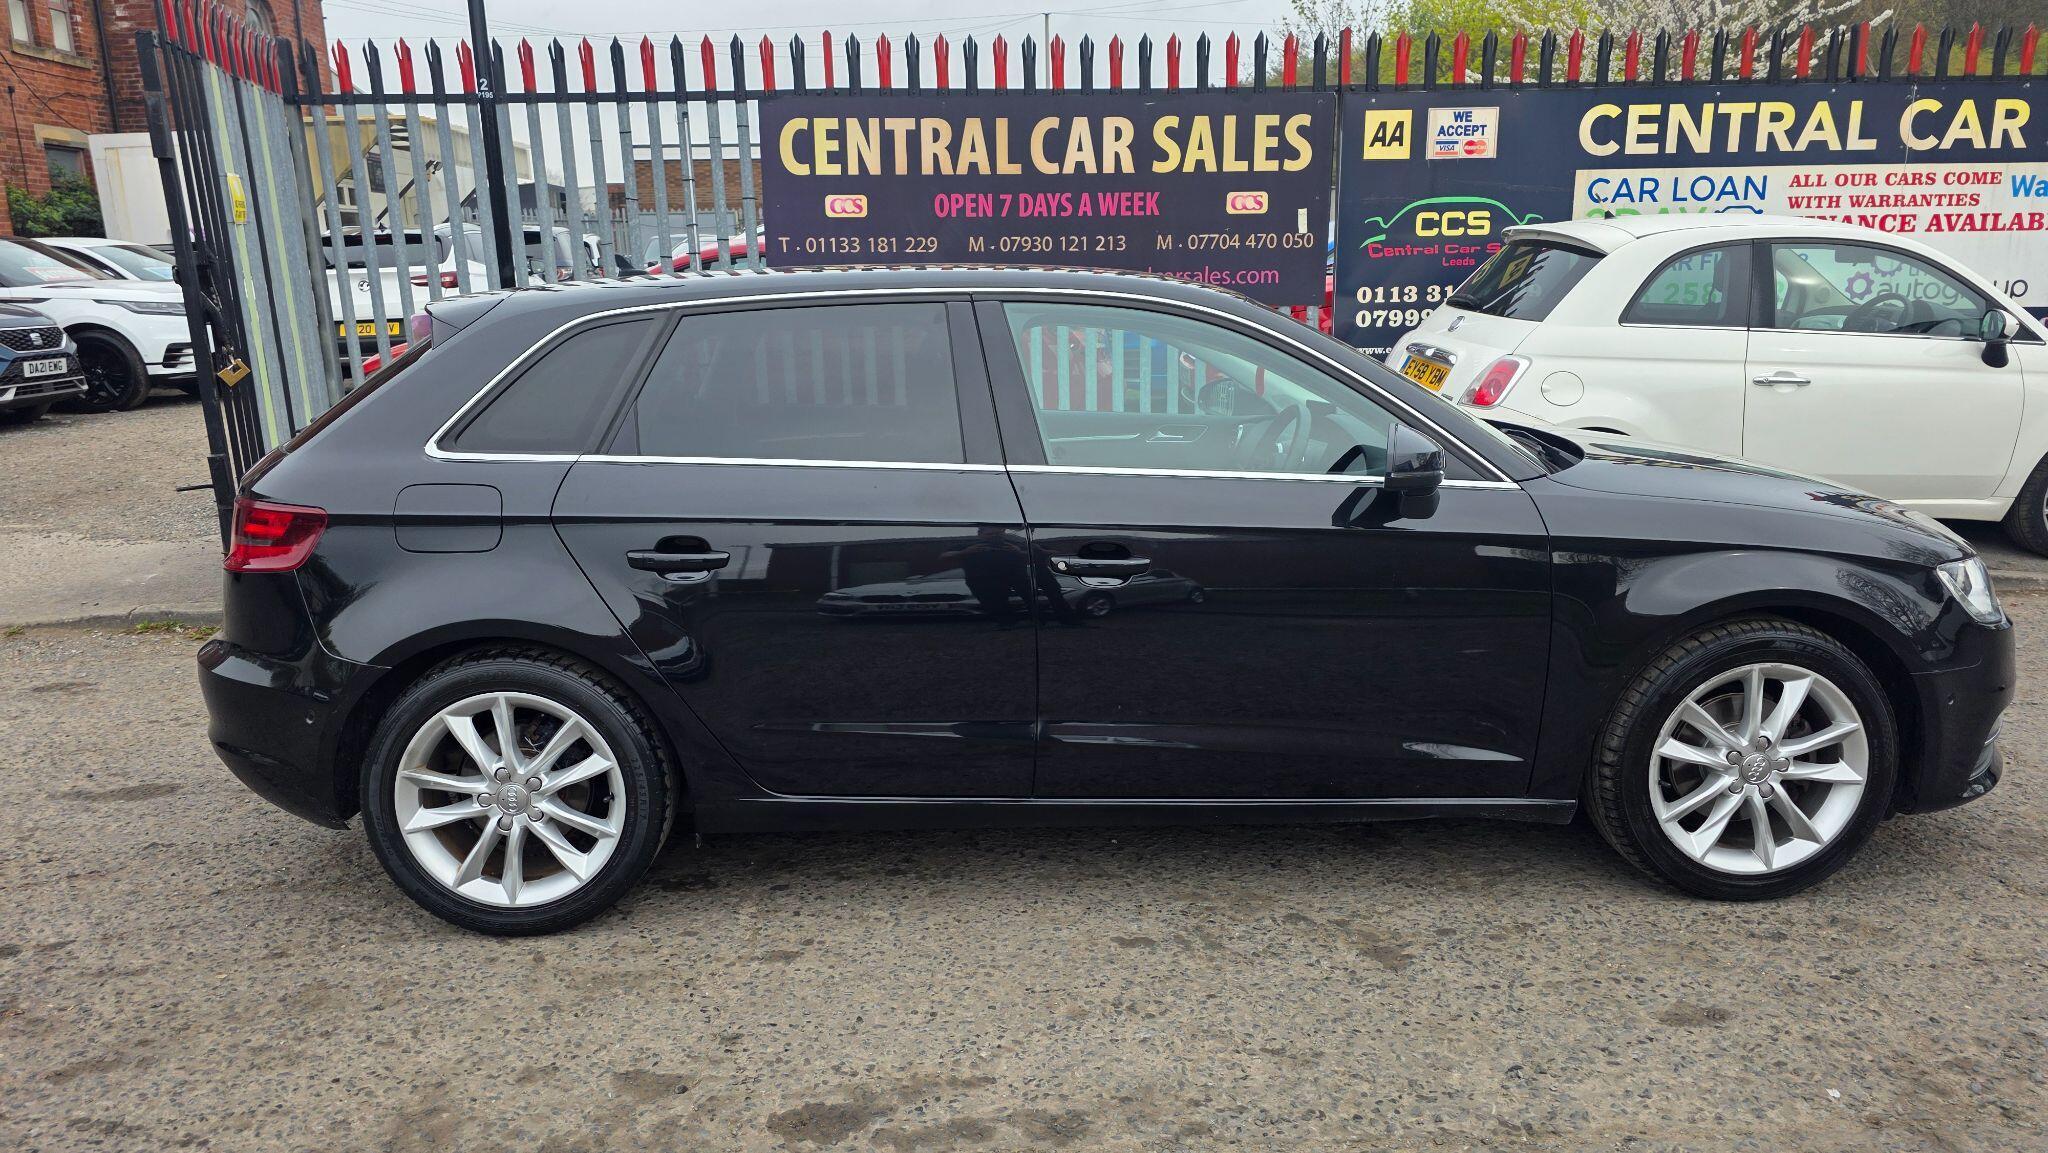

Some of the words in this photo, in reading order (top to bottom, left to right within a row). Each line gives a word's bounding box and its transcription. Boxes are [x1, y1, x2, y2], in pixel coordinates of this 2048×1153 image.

[480, 78, 488, 90] 2
[1453, 111, 1473, 123] WE
[1369, 121, 1405, 147] AA
[1437, 124, 1488, 137] ACCEPT
[1579, 101, 1877, 156] CENTRAL
[1899, 98, 2031, 151] CAR
[779, 117, 1022, 176] CENTRAL
[1030, 116, 1135, 175] CAR
[1152, 114, 1313, 173] SALES
[1788, 173, 1827, 188] ALL
[1834, 172, 1878, 187] OUR
[1885, 171, 1937, 186] CARS
[1943, 171, 2003, 185] COME
[1587, 177, 1660, 204] CAR
[1672, 175, 1768, 202] LOAN
[829, 198, 864, 215] CCS
[934, 193, 993, 218] OPEN
[1000, 193, 1013, 218] 7
[1019, 192, 1073, 217] DAYS
[1078, 192, 1093, 217] A
[1098, 191, 1160, 216] WEEK
[1230, 194, 1264, 211] CCS
[1787, 195, 1841, 209] WITH
[1848, 193, 1981, 208] WARRANTIES
[1415, 210, 1491, 237] CCS
[1798, 213, 1917, 233] ANCE
[1924, 212, 2048, 232] AVAILAB
[805, 236, 861, 253] 01133
[868, 236, 897, 253] 181
[904, 236, 938, 253] 229
[1000, 235, 1053, 252] 07930
[1059, 235, 1088, 251] 121
[1095, 235, 1127, 251] 213
[1187, 234, 1241, 250] 07704
[1245, 233, 1278, 249] 470
[1283, 232, 1314, 248] 050
[1367, 243, 1438, 258] Central
[1444, 244, 1481, 255] Car
[1442, 257, 1475, 267] Leeds
[1356, 285, 1418, 303] 0113
[29, 362, 47, 374] DA21
[1404, 359, 1430, 380] EY58
[1426, 366, 1447, 386] YBM
